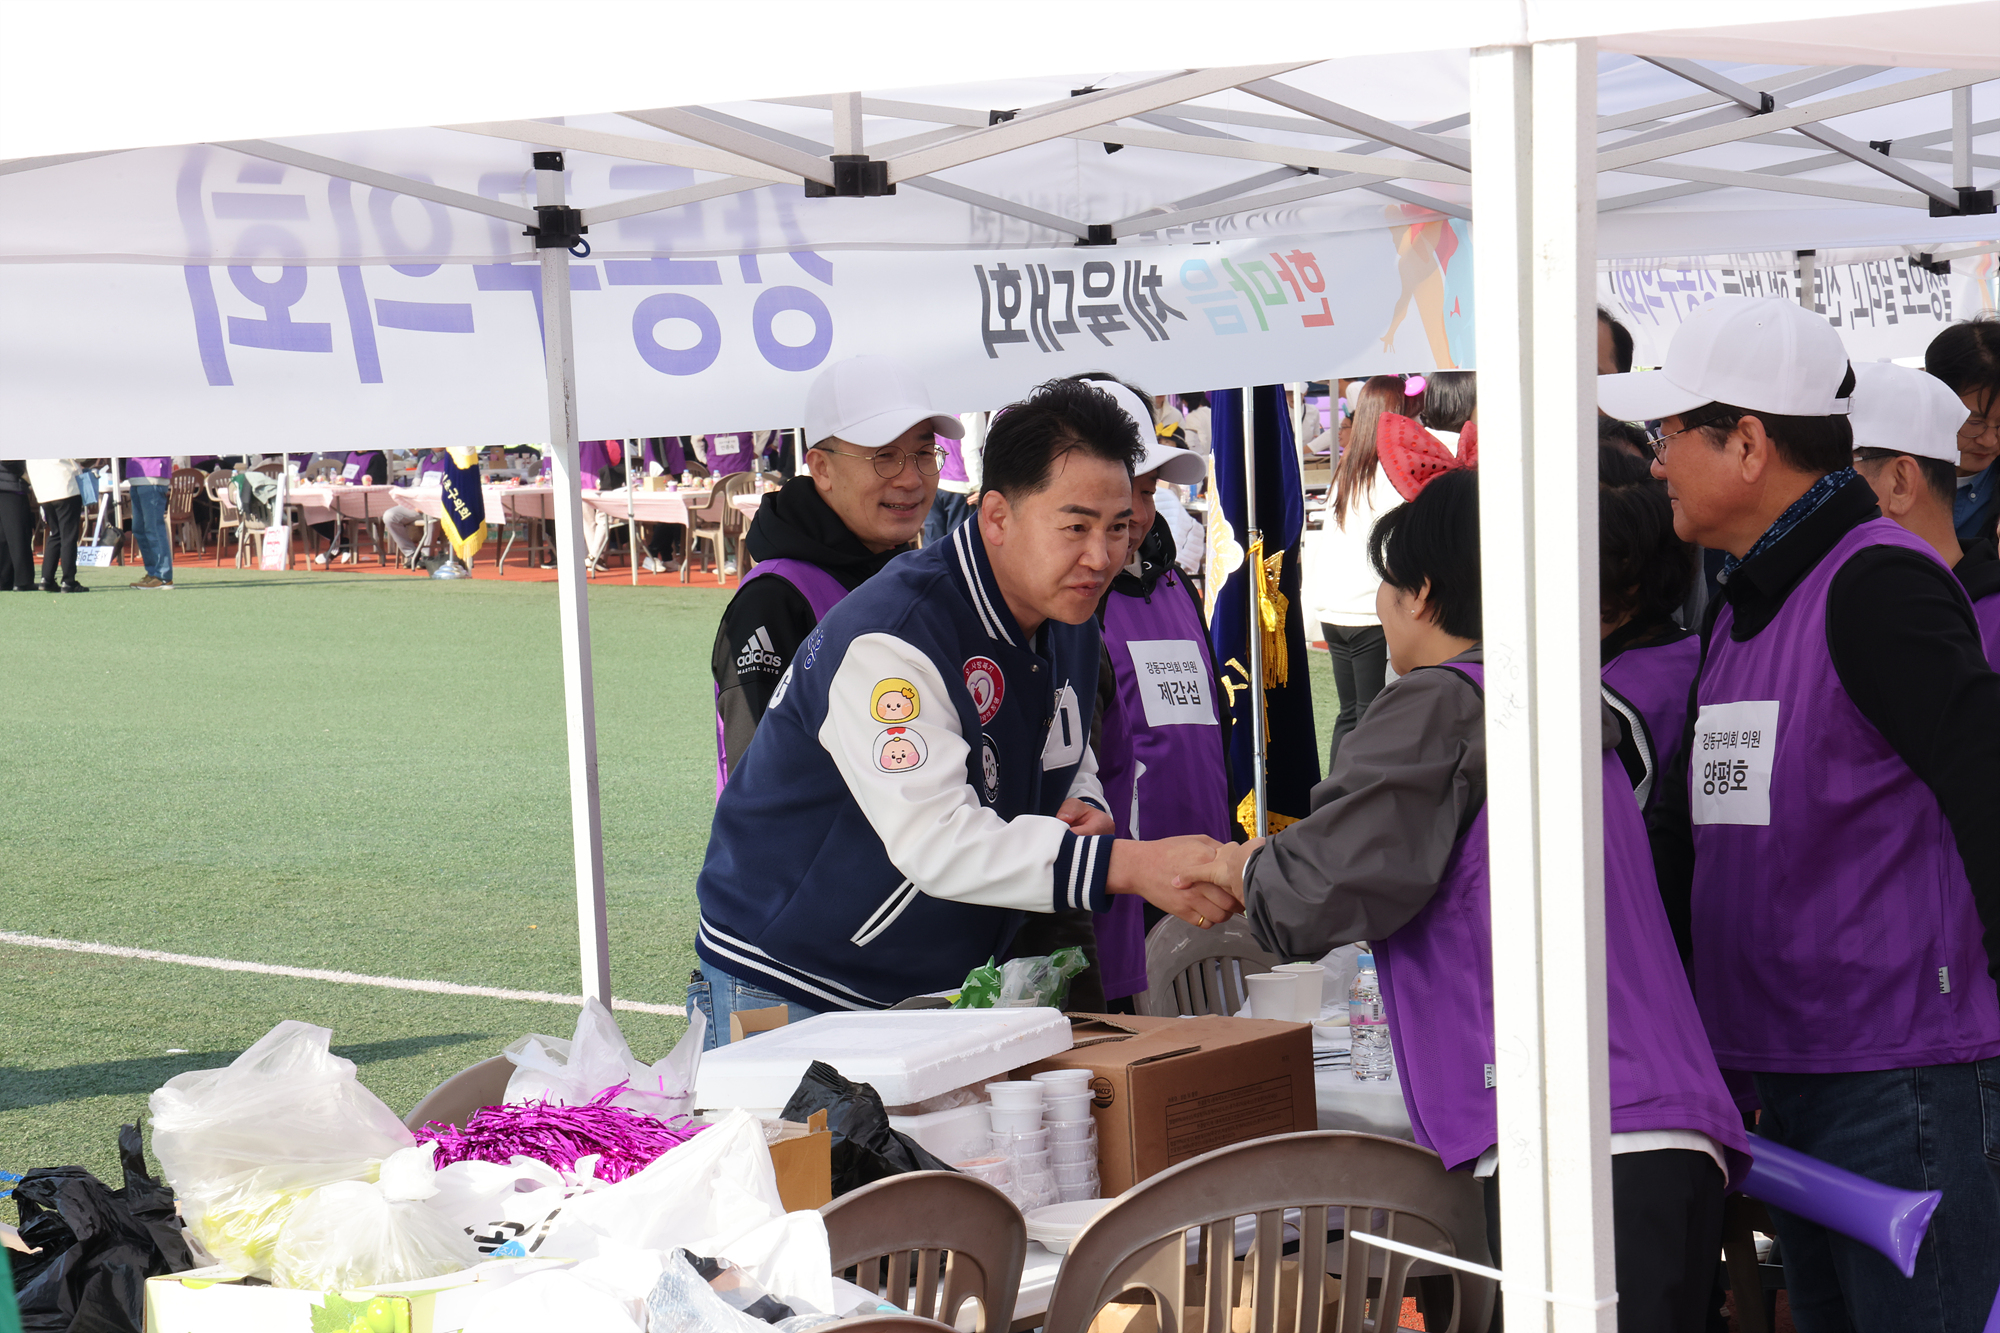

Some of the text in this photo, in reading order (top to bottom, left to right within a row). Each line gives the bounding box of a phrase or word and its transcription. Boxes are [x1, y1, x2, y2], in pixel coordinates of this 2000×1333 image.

[736, 648, 782, 668] adidas
[1145, 660, 1199, 675] 강동구의회 의원
[737, 666, 779, 675] MARTIAL ARTS
[1157, 680, 1201, 706] 제갑섭
[1702, 730, 1761, 751] 강동구의회 의원
[1703, 758, 1749, 796] 양평호
[493, 1246, 518, 1257] 주시
